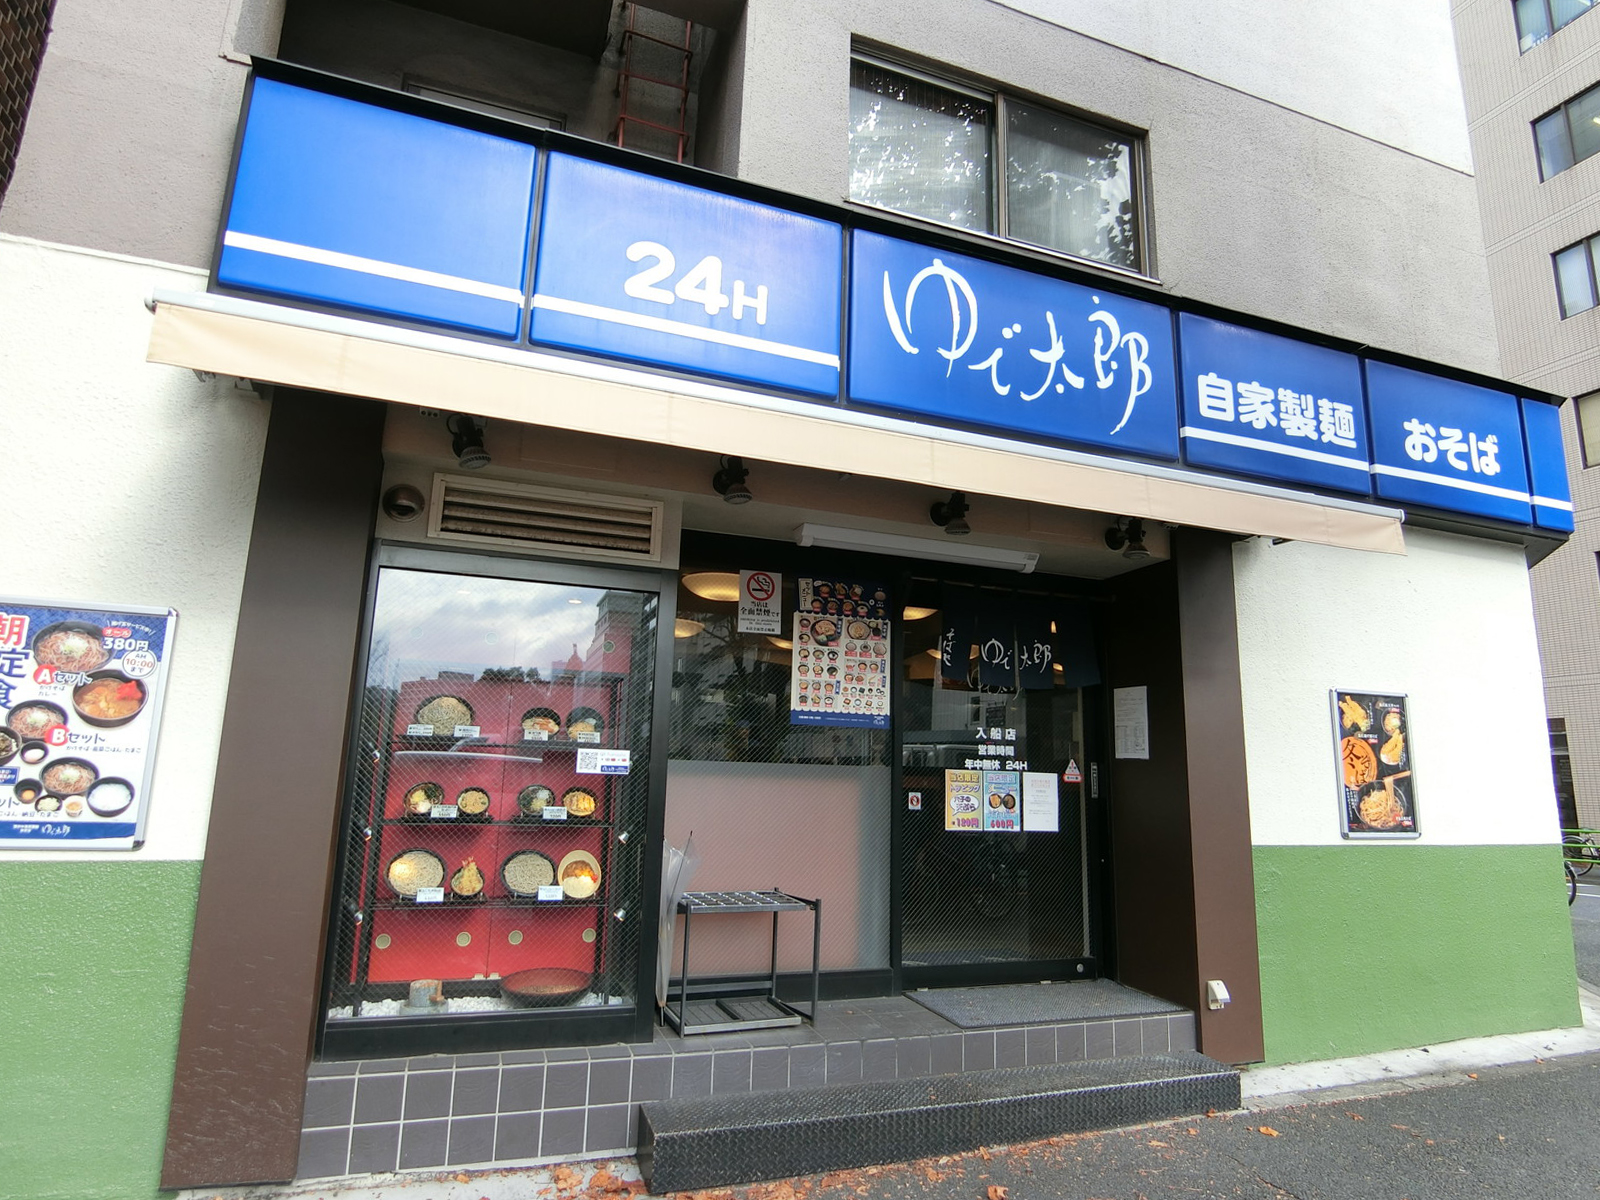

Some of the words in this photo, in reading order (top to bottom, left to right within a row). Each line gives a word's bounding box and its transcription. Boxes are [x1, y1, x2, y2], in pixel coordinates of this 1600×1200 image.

[623, 240, 768, 326] 24H
[883, 258, 1152, 435] ゆで太郎
[1197, 372, 1357, 449] 自家製麺
[1403, 418, 1500, 476] おそば
[103, 637, 149, 652] 380円
[981, 638, 1052, 673] ゆで太郎
[126, 658, 154, 668] 10:00
[976, 727, 1017, 741] 入船店
[978, 744, 1015, 756] 営業時間
[965, 759, 1001, 770] 年中無休
[1005, 761, 1028, 770] 24H
